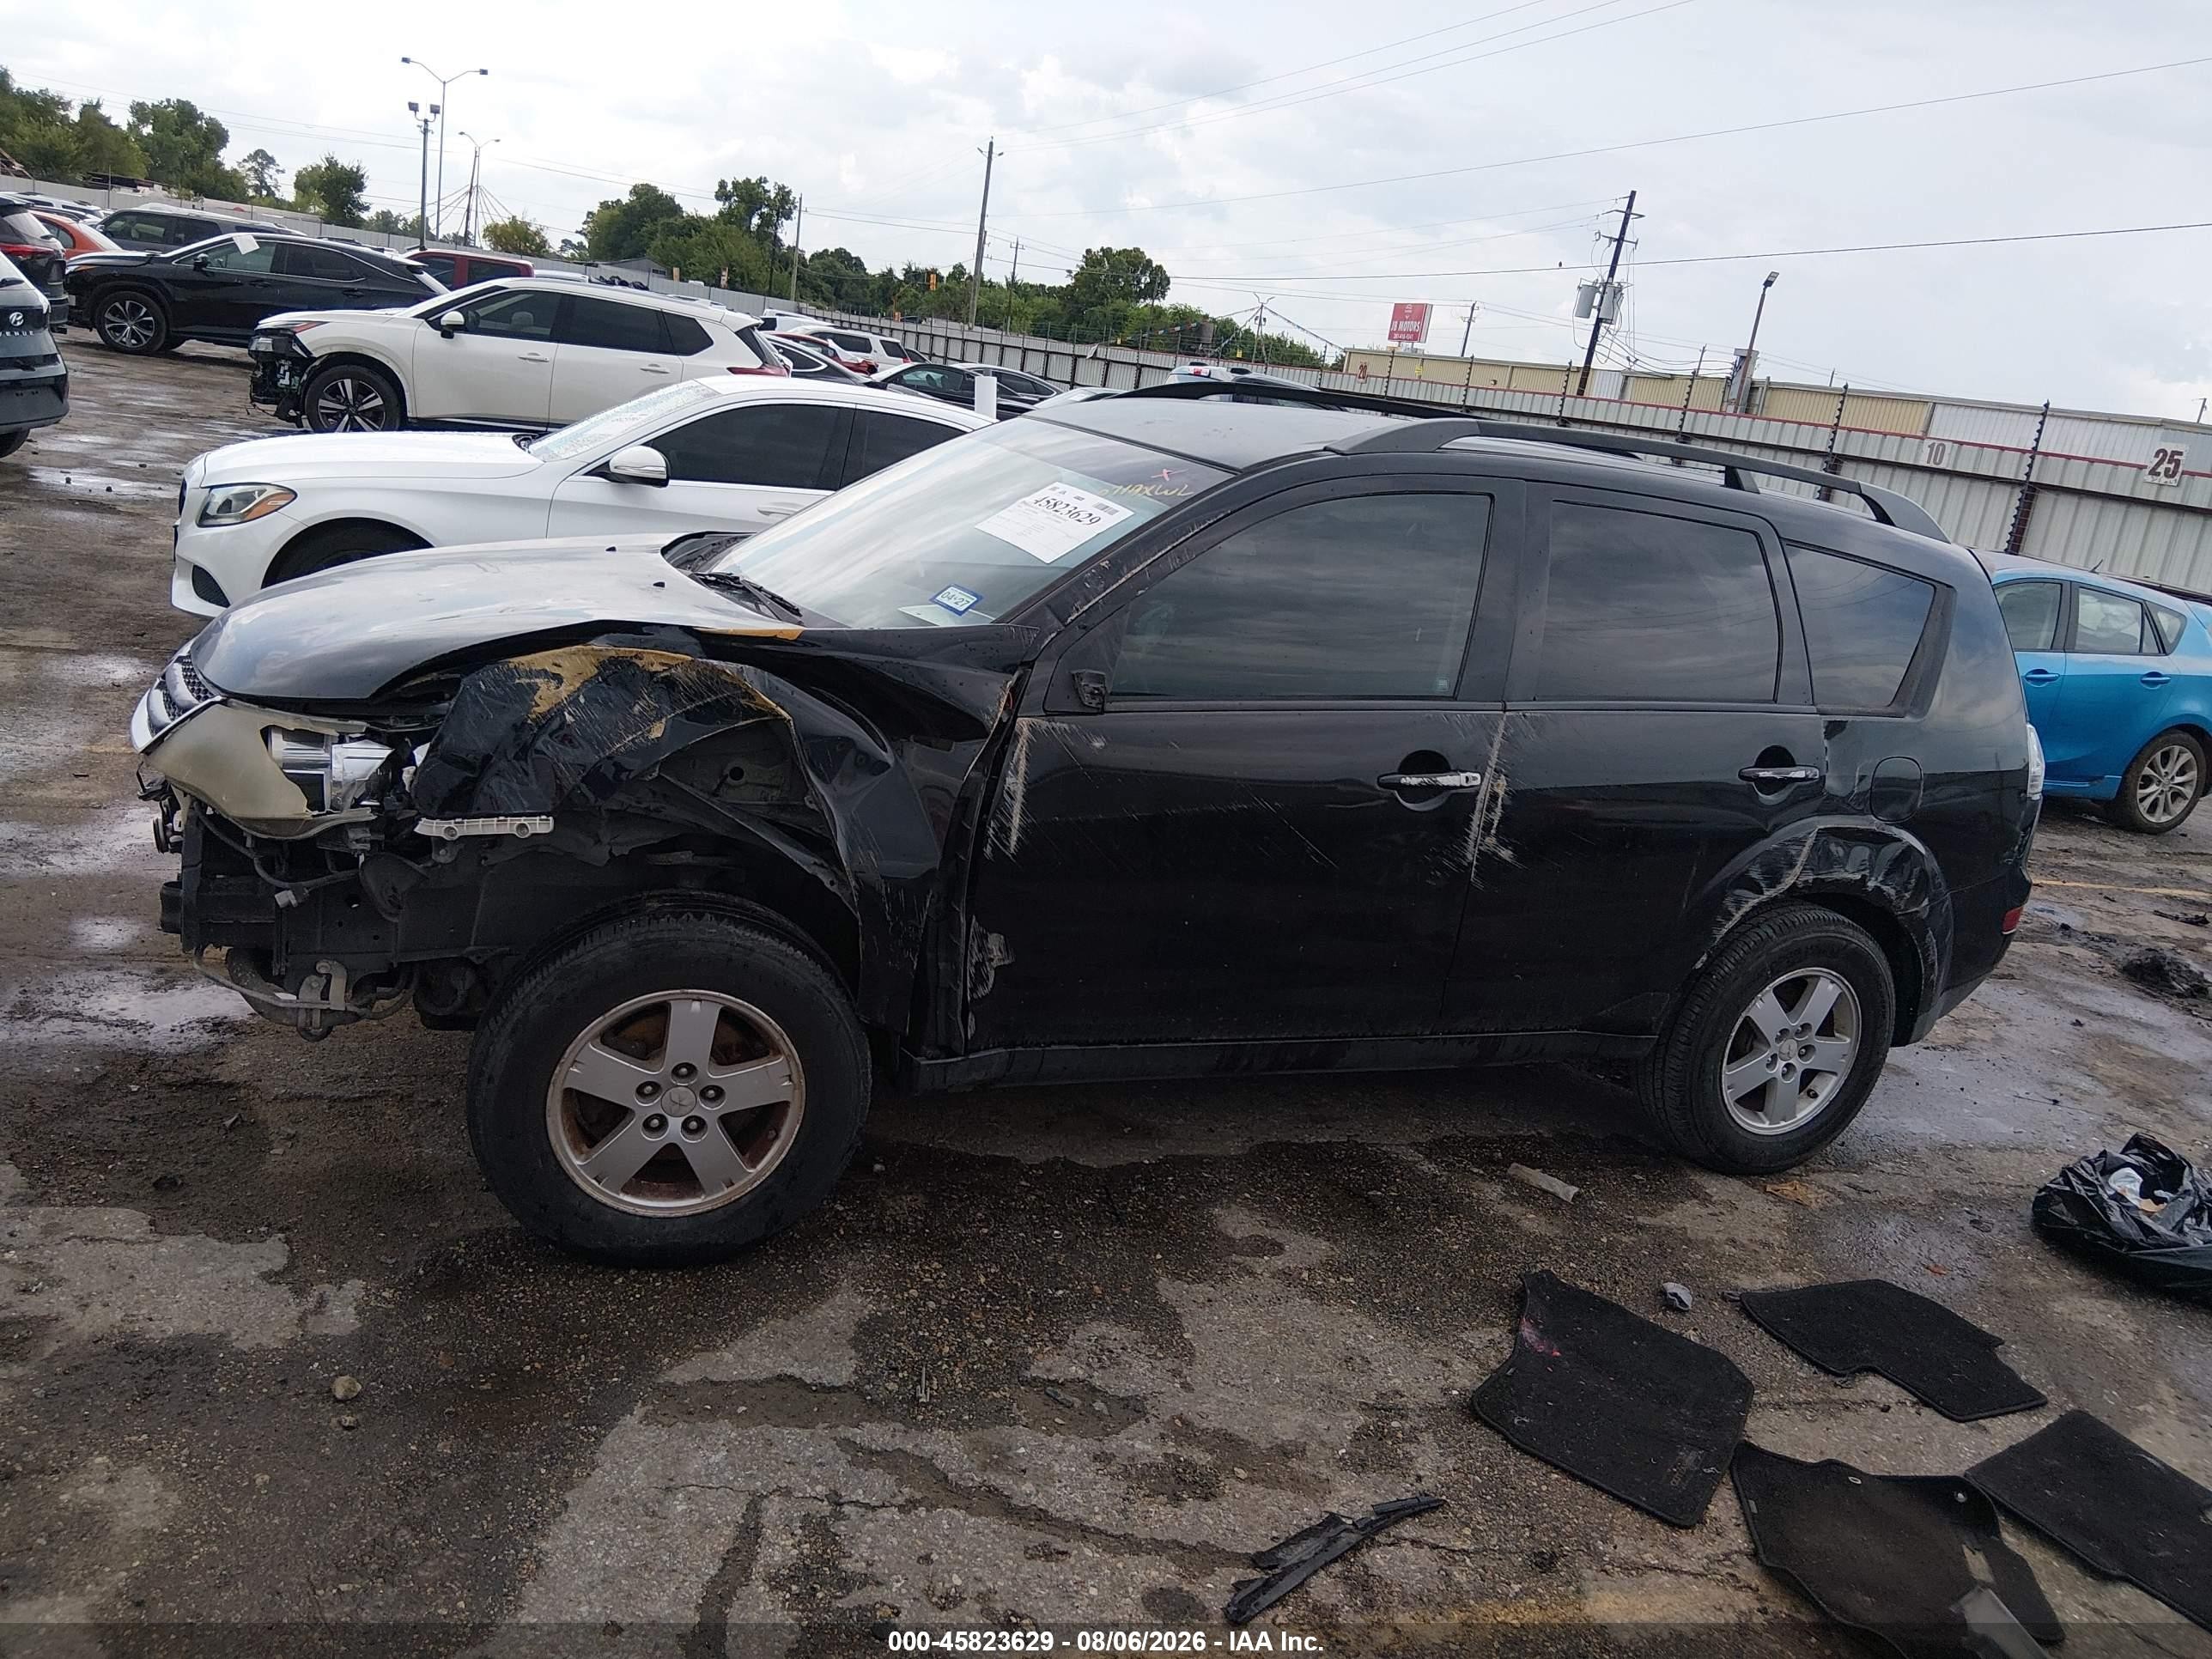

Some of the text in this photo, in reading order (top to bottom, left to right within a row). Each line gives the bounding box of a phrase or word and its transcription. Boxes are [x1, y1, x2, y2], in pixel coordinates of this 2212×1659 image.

[1398, 321, 1420, 332] MOTORS
[1927, 442, 1947, 465] 10
[2148, 448, 2184, 479] 25
[1033, 495, 1101, 526] 45823629
